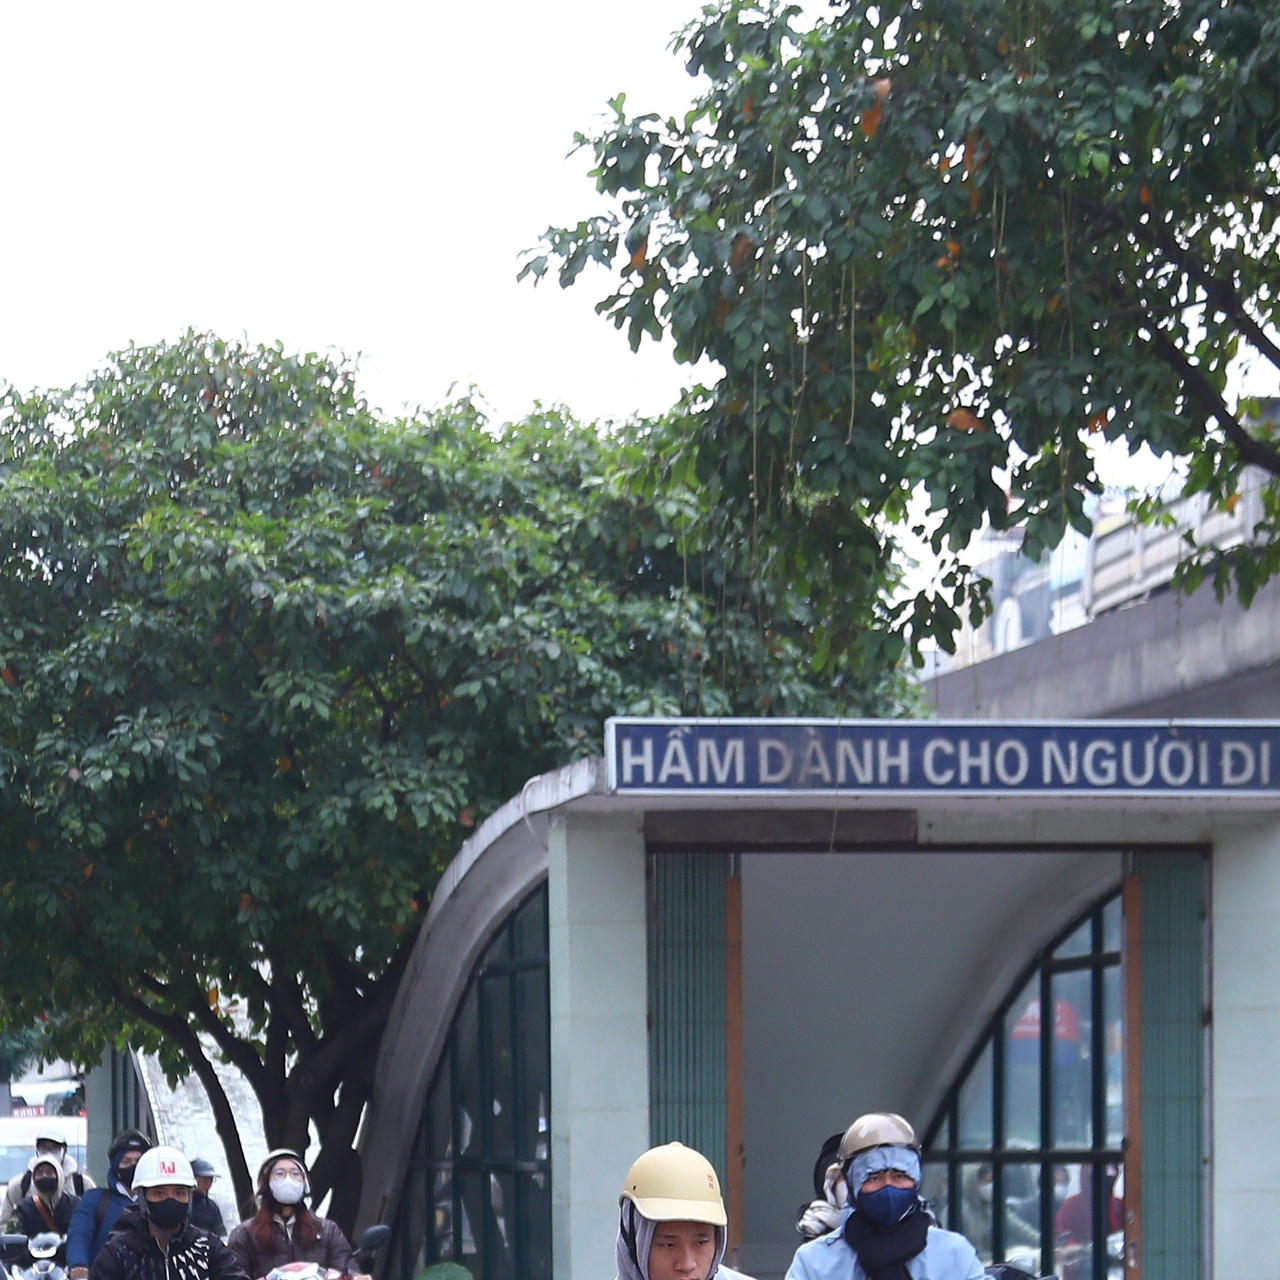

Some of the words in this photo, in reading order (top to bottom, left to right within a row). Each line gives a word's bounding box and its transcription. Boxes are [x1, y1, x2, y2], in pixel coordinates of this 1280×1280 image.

[759, 728, 910, 785] DÀNH
[923, 738, 1029, 785] CHO
[1221, 740, 1270, 785] ĐI
